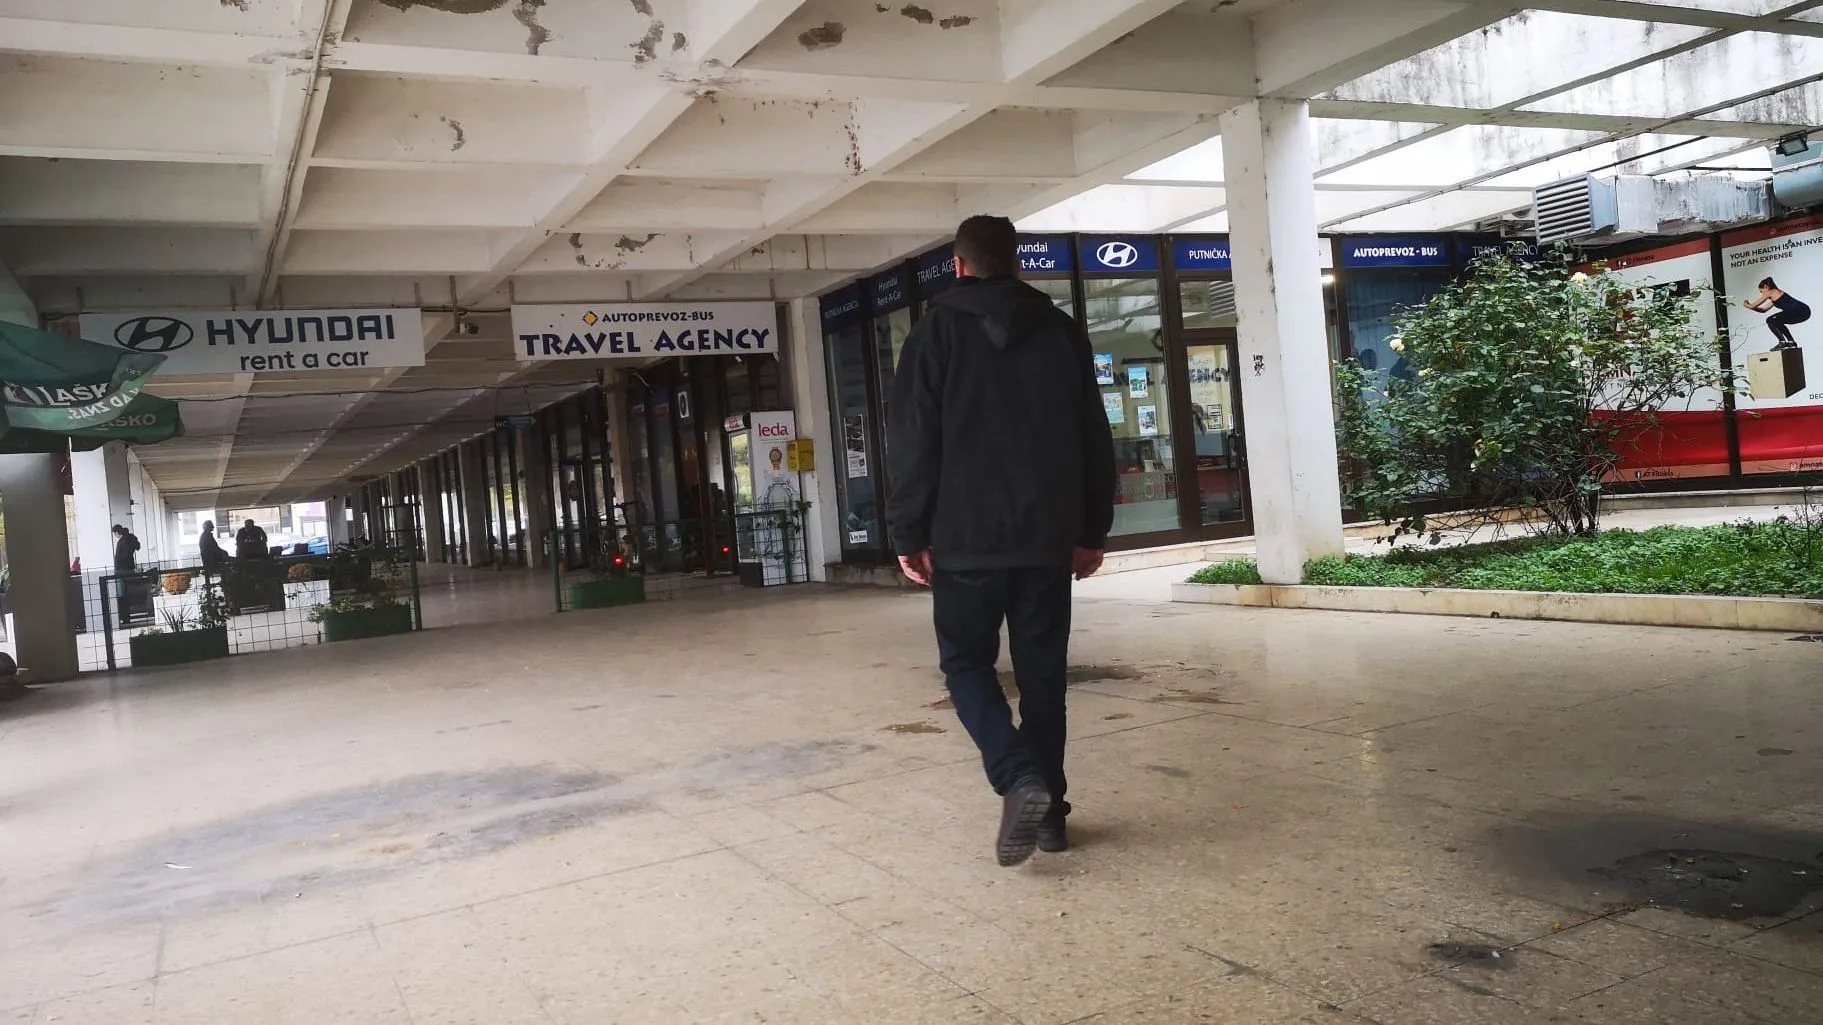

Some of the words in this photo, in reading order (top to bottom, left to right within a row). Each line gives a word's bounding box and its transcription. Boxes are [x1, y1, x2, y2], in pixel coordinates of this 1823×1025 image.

[1188, 247, 1228, 260] PUTNIČKA
[1353, 247, 1415, 258] AUTOPREVOZ
[1421, 247, 1438, 256] BUS
[1729, 250, 1750, 261] YOUR
[1752, 244, 1781, 256] HEALTH
[1782, 243, 1790, 251] IS
[1790, 240, 1803, 249] AN
[1804, 236, 1823, 246] INVE
[1020, 257, 1055, 270] t-A-Car
[1730, 260, 1746, 268] NOT
[1747, 257, 1759, 265] AN
[1760, 251, 1793, 263] EXPENSE
[916, 267, 942, 284] TRAVEL
[602, 311, 714, 324] AUTOPREVOZ-BUS
[206, 314, 395, 346] HYUNDAI
[519, 331, 641, 356] TRAVEL
[653, 328, 769, 352] AGENCY
[240, 351, 296, 371] rent
[302, 352, 319, 368] a
[326, 350, 369, 367] car
[758, 422, 790, 438] leda
